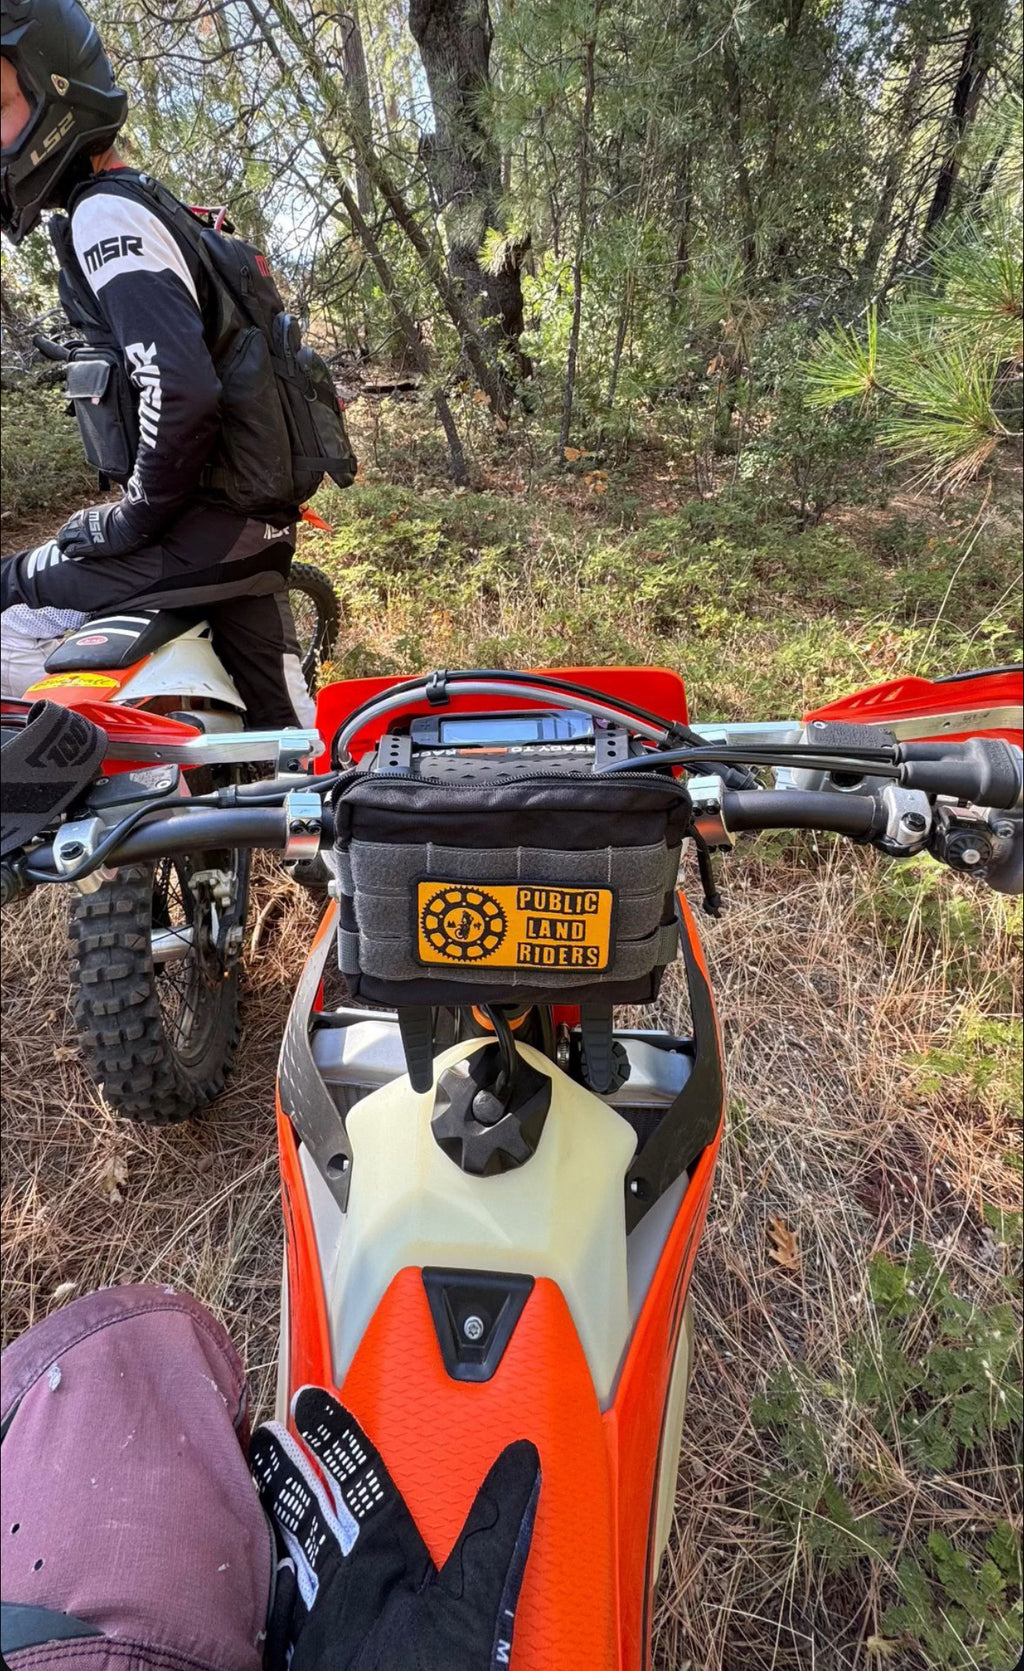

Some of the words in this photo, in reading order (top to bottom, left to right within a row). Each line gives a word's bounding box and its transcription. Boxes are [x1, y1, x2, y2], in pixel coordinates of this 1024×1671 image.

[30, 111, 75, 166] LS2
[83, 235, 145, 275] MSR
[88, 511, 105, 543] MSR
[519, 890, 598, 913] PUBLIC
[528, 918, 584, 940] LAND
[519, 943, 599, 966] RIDERS
